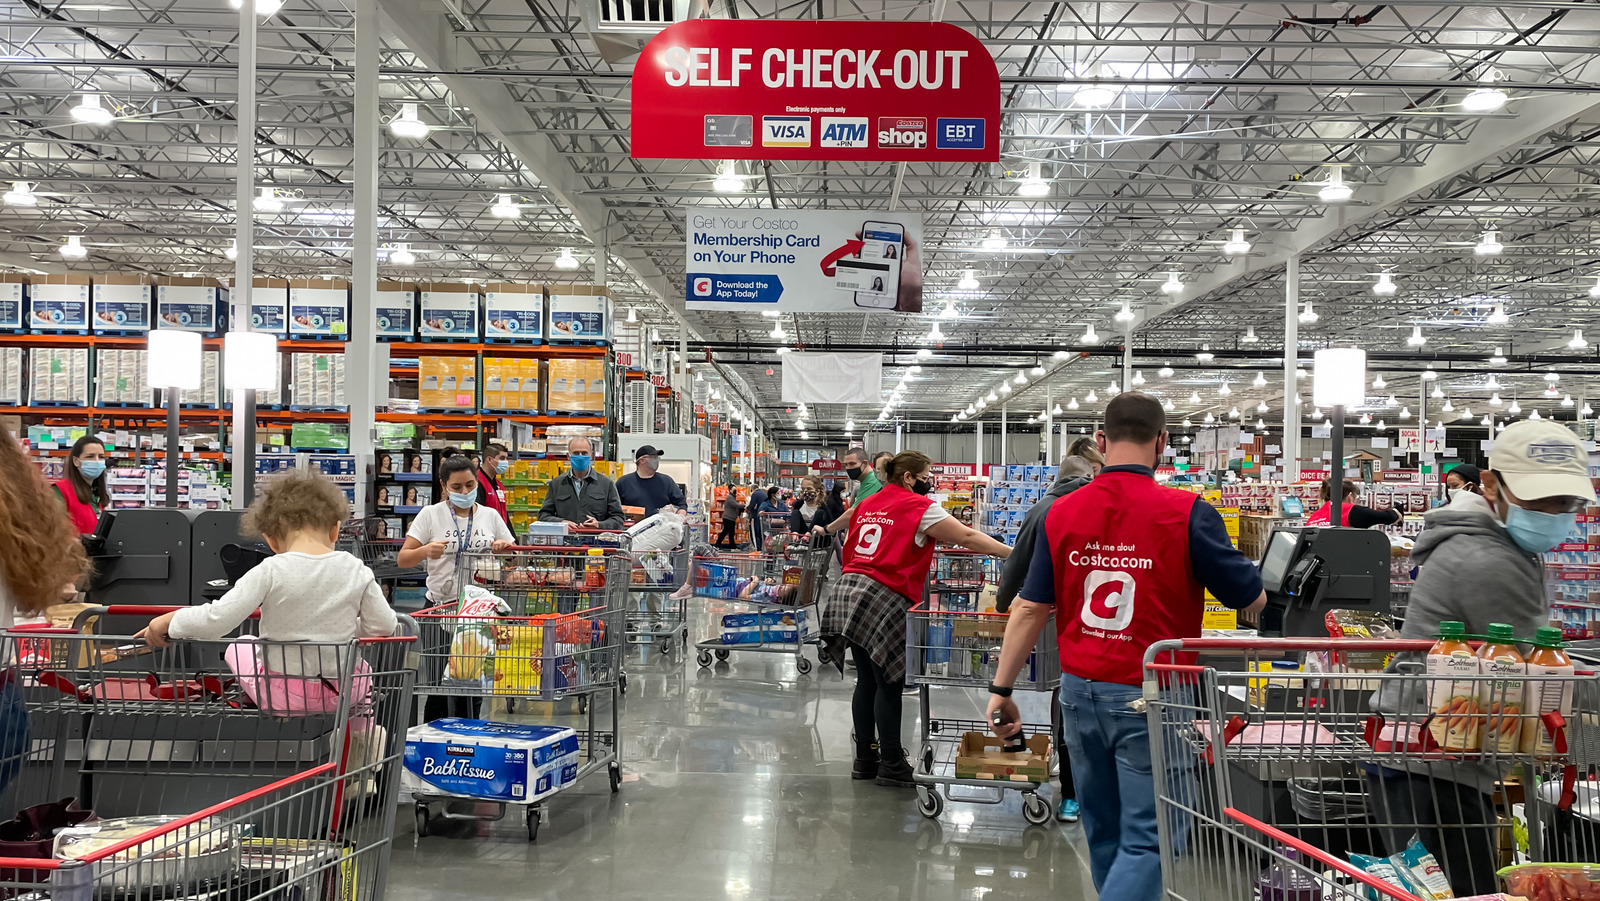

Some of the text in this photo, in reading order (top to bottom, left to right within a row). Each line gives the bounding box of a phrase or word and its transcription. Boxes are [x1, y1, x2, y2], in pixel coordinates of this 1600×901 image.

[664, 46, 968, 90] SELF CHECK-OUT
[768, 125, 805, 138] VISA
[822, 124, 867, 141] ATM
[878, 128, 926, 148] shop
[946, 125, 976, 138] EBT
[693, 215, 798, 230] Get Your Costco
[694, 233, 820, 249] Membership Card
[694, 250, 796, 263] on Your Phone
[716, 281, 754, 289] Download
[617, 353, 631, 366] 300
[651, 376, 666, 386] 302
[1085, 541, 1100, 550] Ask
[1081, 627, 1105, 638] Download
[1118, 633, 1132, 641] App
[1443, 657, 1477, 666] Bolthouse
[1486, 662, 1523, 673] Bolthouse
[423, 757, 495, 780] Bath Tissue
